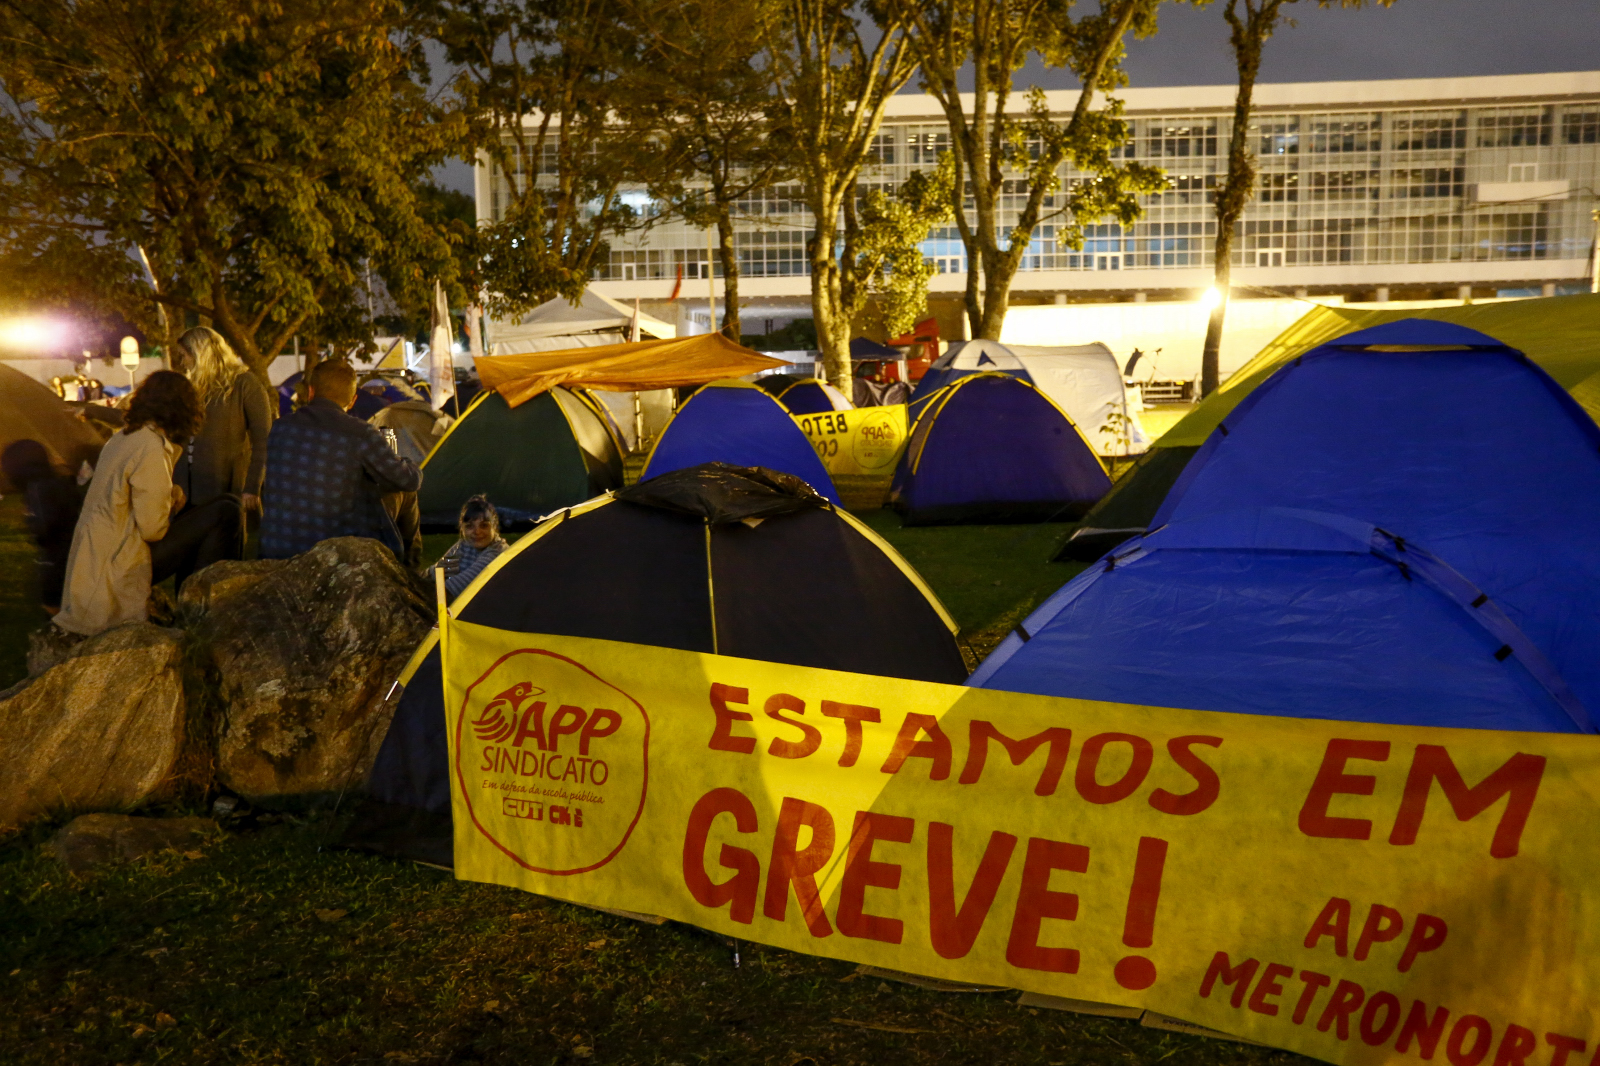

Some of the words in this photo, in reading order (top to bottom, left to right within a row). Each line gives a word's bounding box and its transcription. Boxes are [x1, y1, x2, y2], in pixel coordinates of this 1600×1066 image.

[513, 701, 622, 756] APP
[481, 746, 608, 785] SINDICATO
[483, 780, 498, 789] Em
[500, 780, 527, 797] defesa
[528, 783, 541, 795] da
[543, 788, 567, 798] escola
[568, 790, 604, 804] pública
[709, 683, 1223, 816] ESTAMOS
[1299, 739, 1547, 860] EM
[503, 797, 544, 821] CUT
[683, 788, 1168, 991] GREVE!
[1304, 896, 1449, 973] APP
[1199, 951, 1600, 1066] METRONORT
